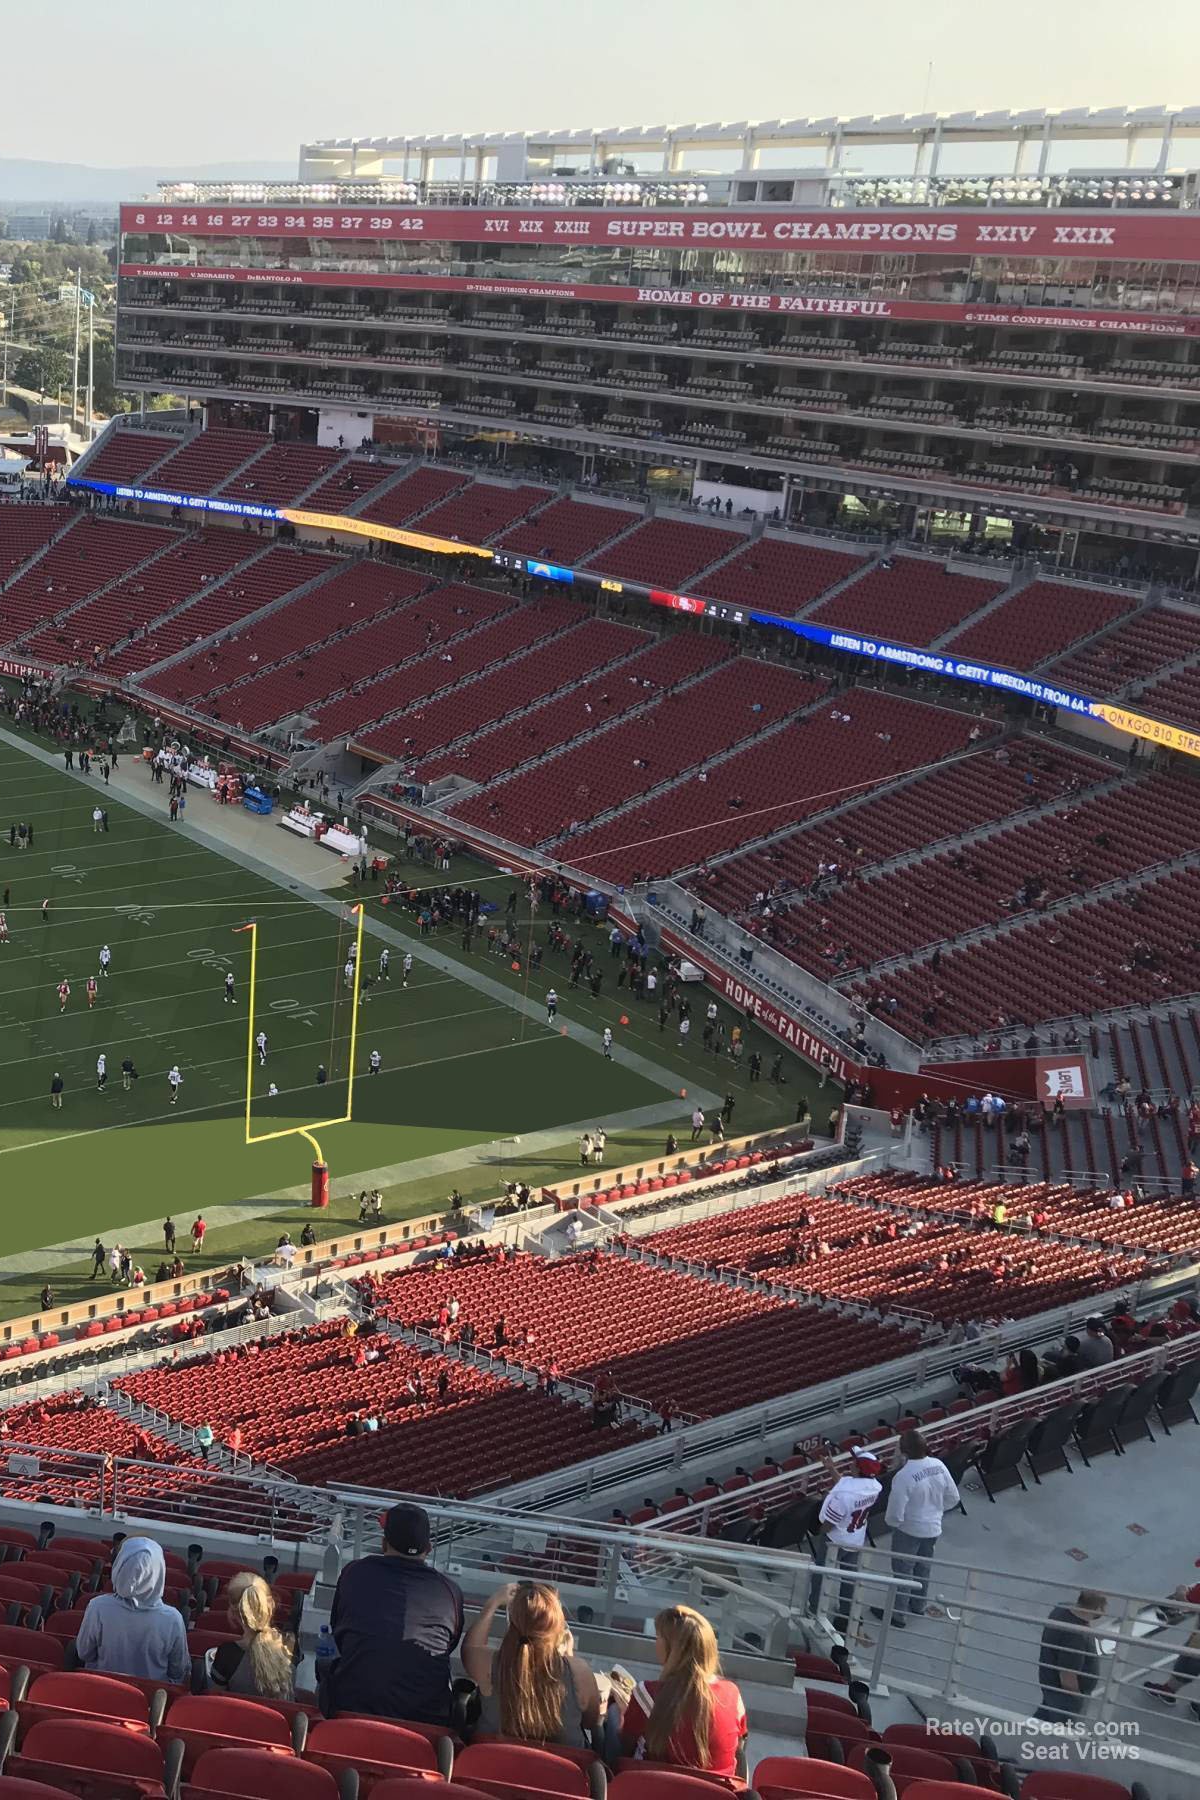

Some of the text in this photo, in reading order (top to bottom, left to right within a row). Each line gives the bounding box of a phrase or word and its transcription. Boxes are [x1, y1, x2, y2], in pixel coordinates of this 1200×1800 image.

[136, 214, 424, 231] 8 12 14 16 27 33 34 35 37 39 42
[484, 219, 1116, 245] XVI XIX XXIII SUPER BOWL CHAMPIONS XXIV XXIX
[494, 286, 527, 294] DIVISION
[529, 288, 575, 297] CHAMPIONS
[637, 288, 891, 316] HOME OF THE FAITHFUL
[965, 313, 1186, 333] 6-TIME CONFERENCE CHAMPIONS
[116, 487, 134, 498] LISTEN
[134, 489, 143, 498] TO
[144, 491, 182, 504] ARMSTRONG
[183, 497, 188, 505] &
[189, 498, 208, 508] GETTY
[208, 500, 242, 513] WEEKDAYS
[243, 504, 262, 515] FROM
[831, 634, 861, 651] LISTEN
[862, 639, 876, 655] TO
[877, 644, 944, 672] ARMSTRONG
[945, 659, 955, 673] &
[956, 663, 989, 682] GETTY
[991, 671, 1042, 697] WEEKDAYS
[1043, 687, 1070, 708] FROM
[1108, 711, 1125, 725] ON
[1128, 717, 1152, 734] KGO
[725, 977, 847, 1081] HOME of the FAITHFUL
